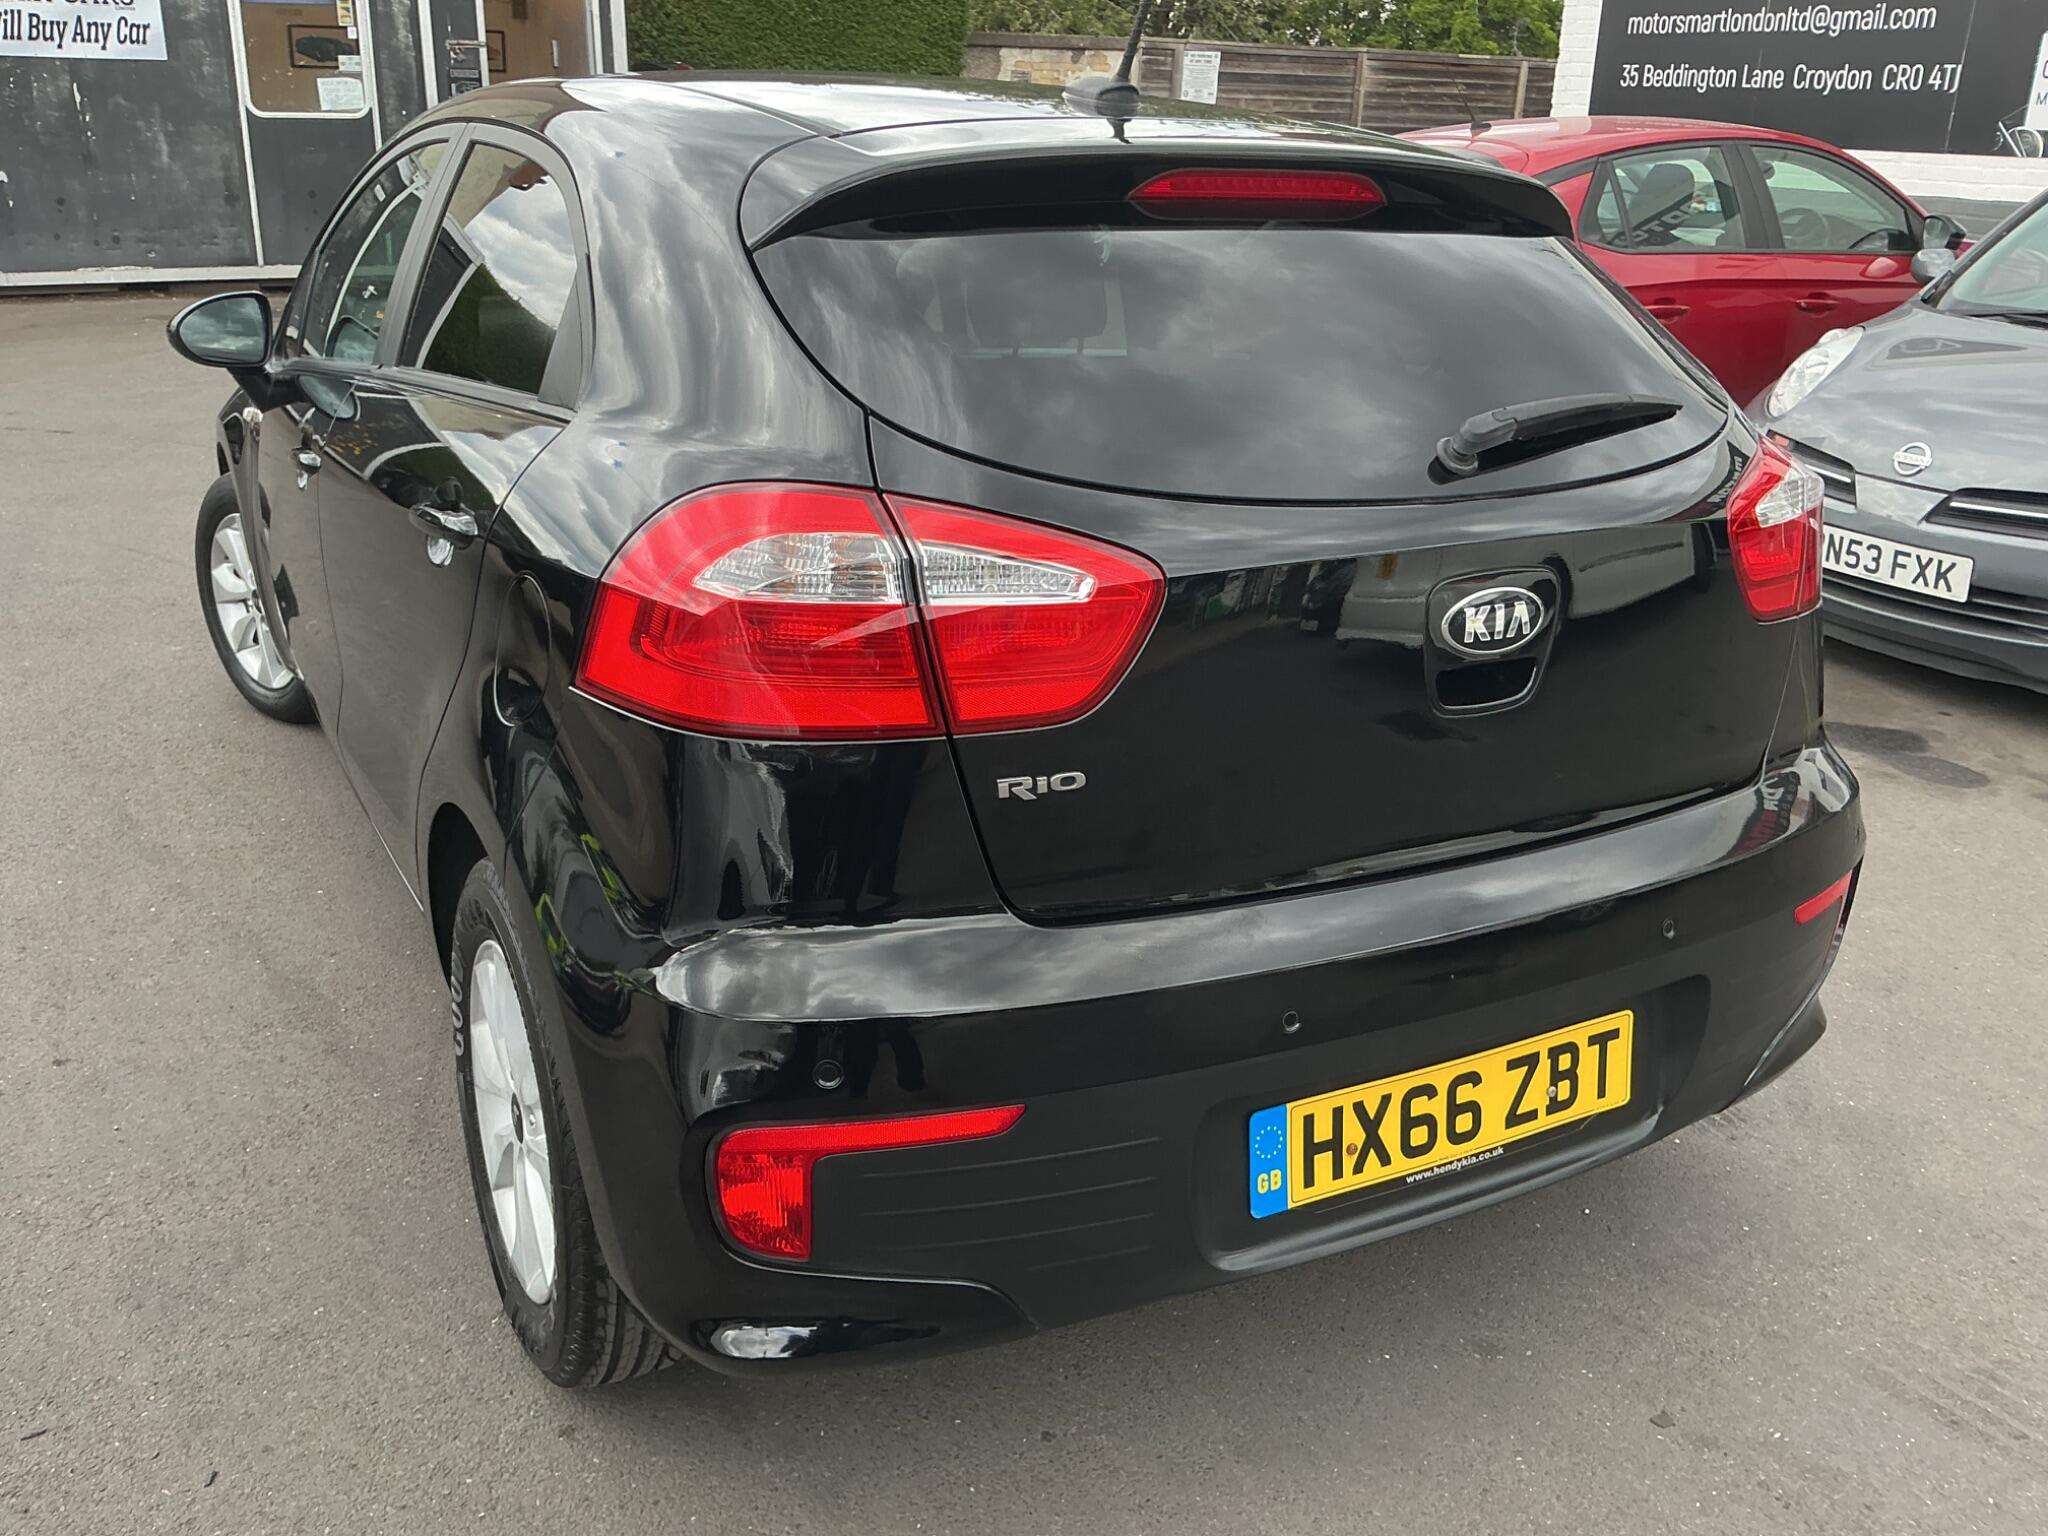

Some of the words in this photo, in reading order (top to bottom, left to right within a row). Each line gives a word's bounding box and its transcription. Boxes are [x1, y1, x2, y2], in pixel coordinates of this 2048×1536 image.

[0, 9, 22, 40] ill
[28, 13, 67, 49] Buy
[72, 15, 112, 50] Any
[117, 16, 151, 45] Car
[1627, 3, 1937, 37] motorsmartlondonltd@gmail.com
[1620, 64, 1639, 87] 35
[1643, 64, 1737, 93] Beddington
[1742, 64, 1784, 89] Lane
[1793, 64, 1872, 95] Croydon
[1928, 64, 1963, 94] 4TJ
[1823, 532, 1882, 575] N53
[1890, 549, 1957, 593] FXK
[1464, 600, 1531, 643] KIA
[1302, 1070, 1482, 1189] HX66
[1505, 1027, 1621, 1131] ZBT
[1257, 1169, 1282, 1194] GB
[1405, 1146, 1504, 1184] www.hendykia.co.uk
